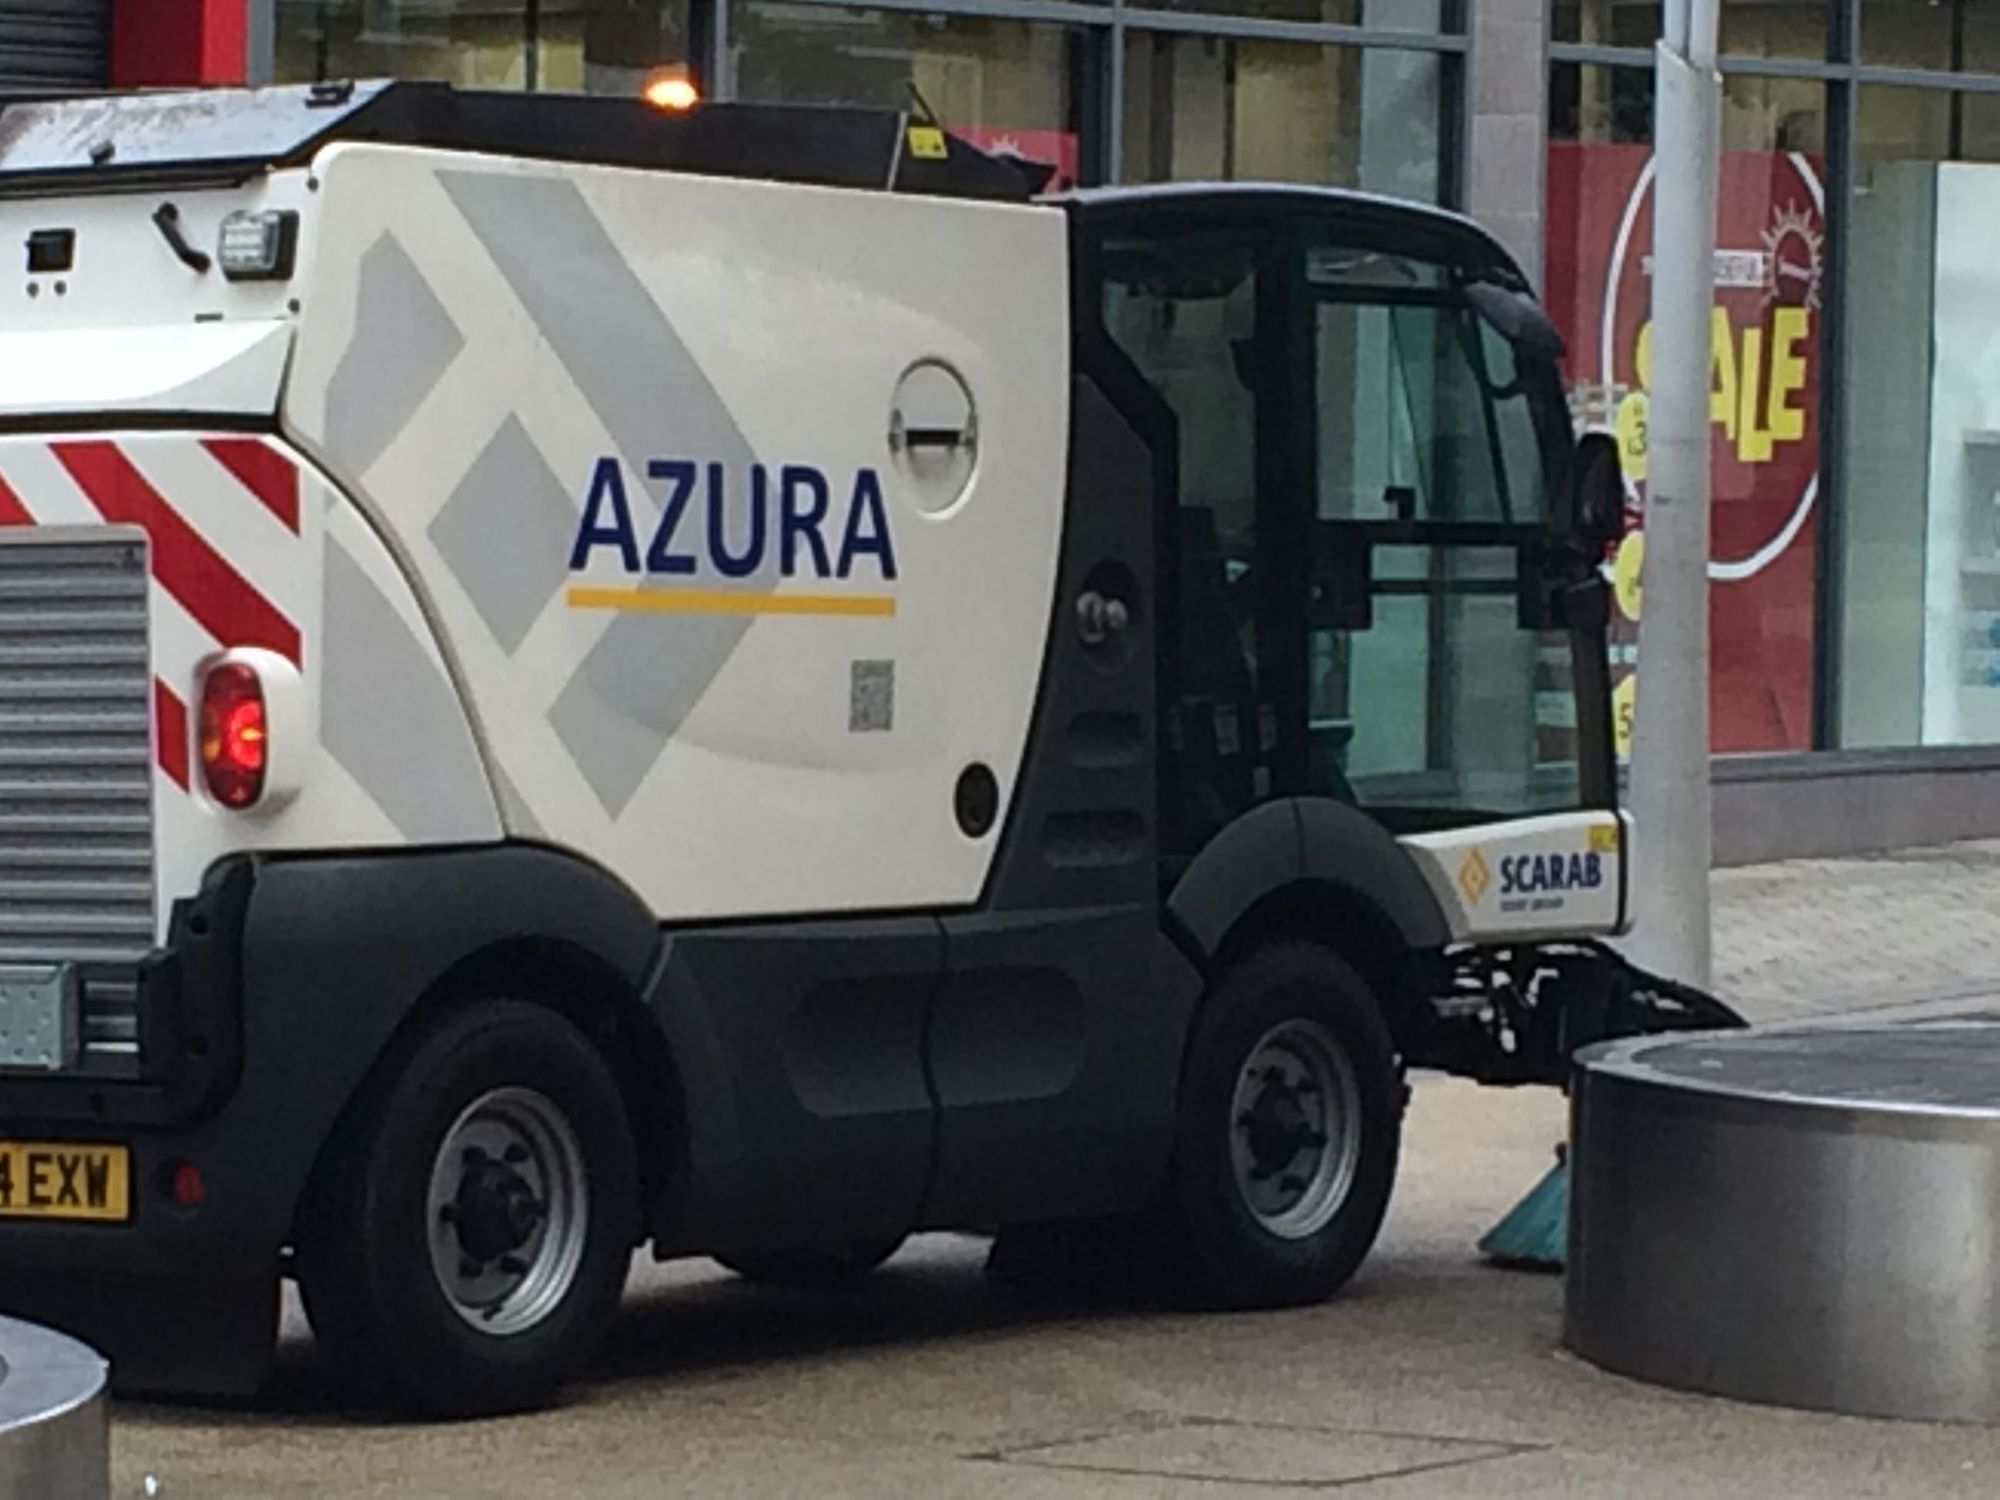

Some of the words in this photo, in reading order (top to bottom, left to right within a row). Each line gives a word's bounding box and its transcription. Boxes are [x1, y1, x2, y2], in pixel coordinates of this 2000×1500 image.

[568, 457, 897, 580] AZURA
[1500, 852, 1603, 893] SCARAB
[28, 1153, 110, 1208] EXW
